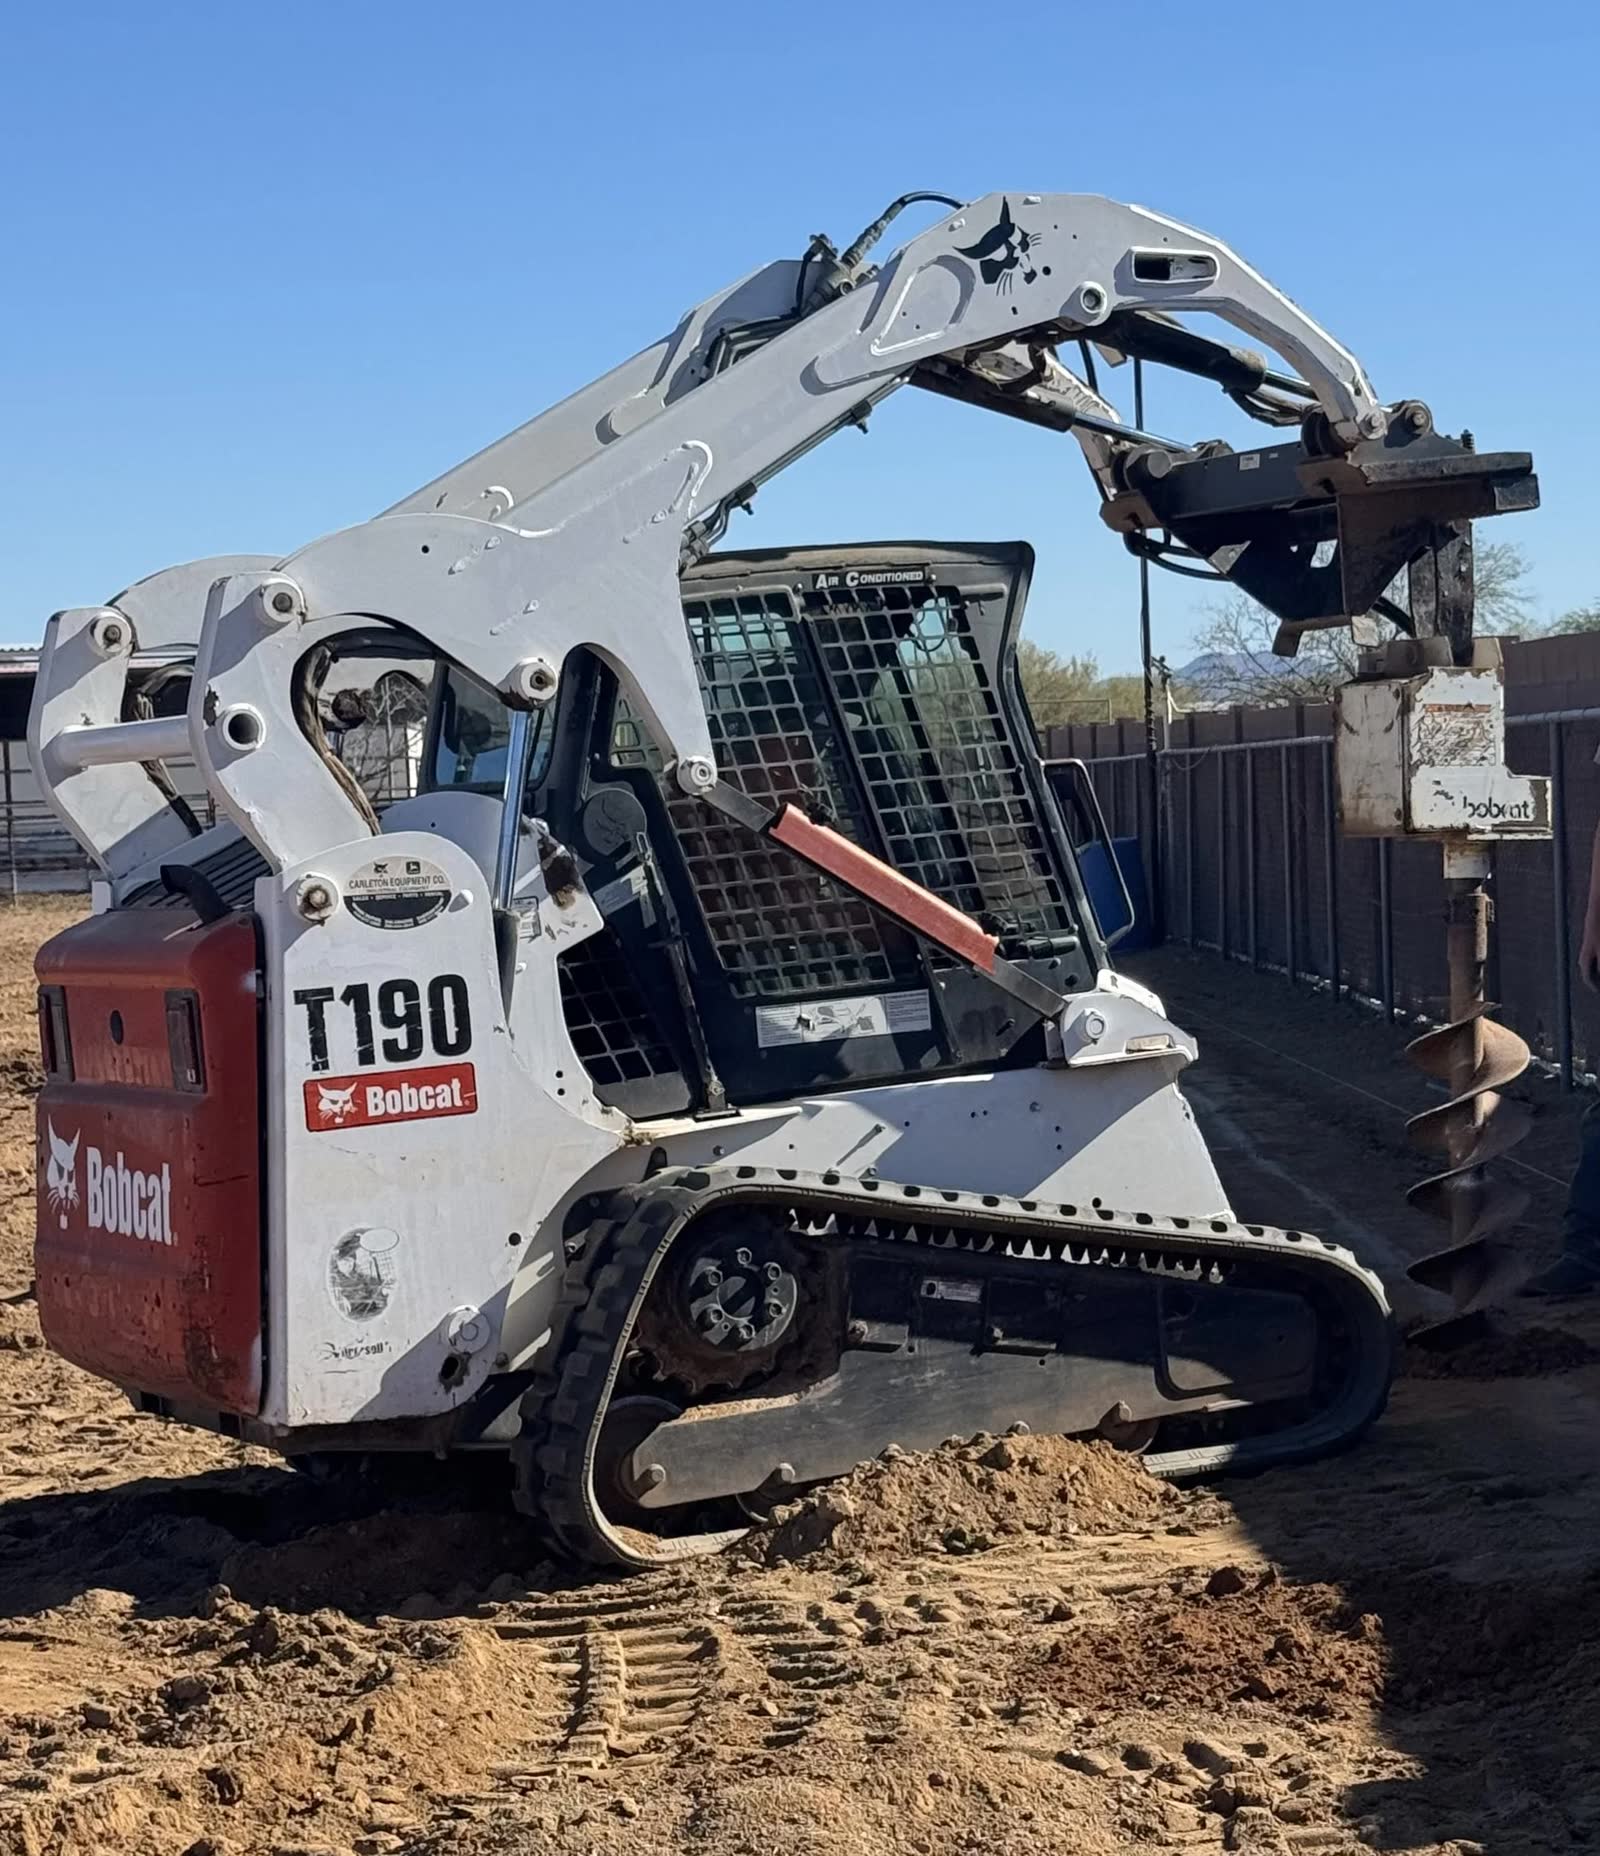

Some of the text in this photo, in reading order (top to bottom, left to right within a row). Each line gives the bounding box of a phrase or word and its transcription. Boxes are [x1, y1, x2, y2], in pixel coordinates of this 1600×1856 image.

[815, 571, 923, 589] AIR CONDITIONED
[349, 878, 389, 889] CARLETON
[390, 876, 431, 887] EQUIPMENT
[293, 974, 472, 1072] T190
[366, 1078, 463, 1117] Bobcat
[86, 1146, 172, 1246] Bobcat
